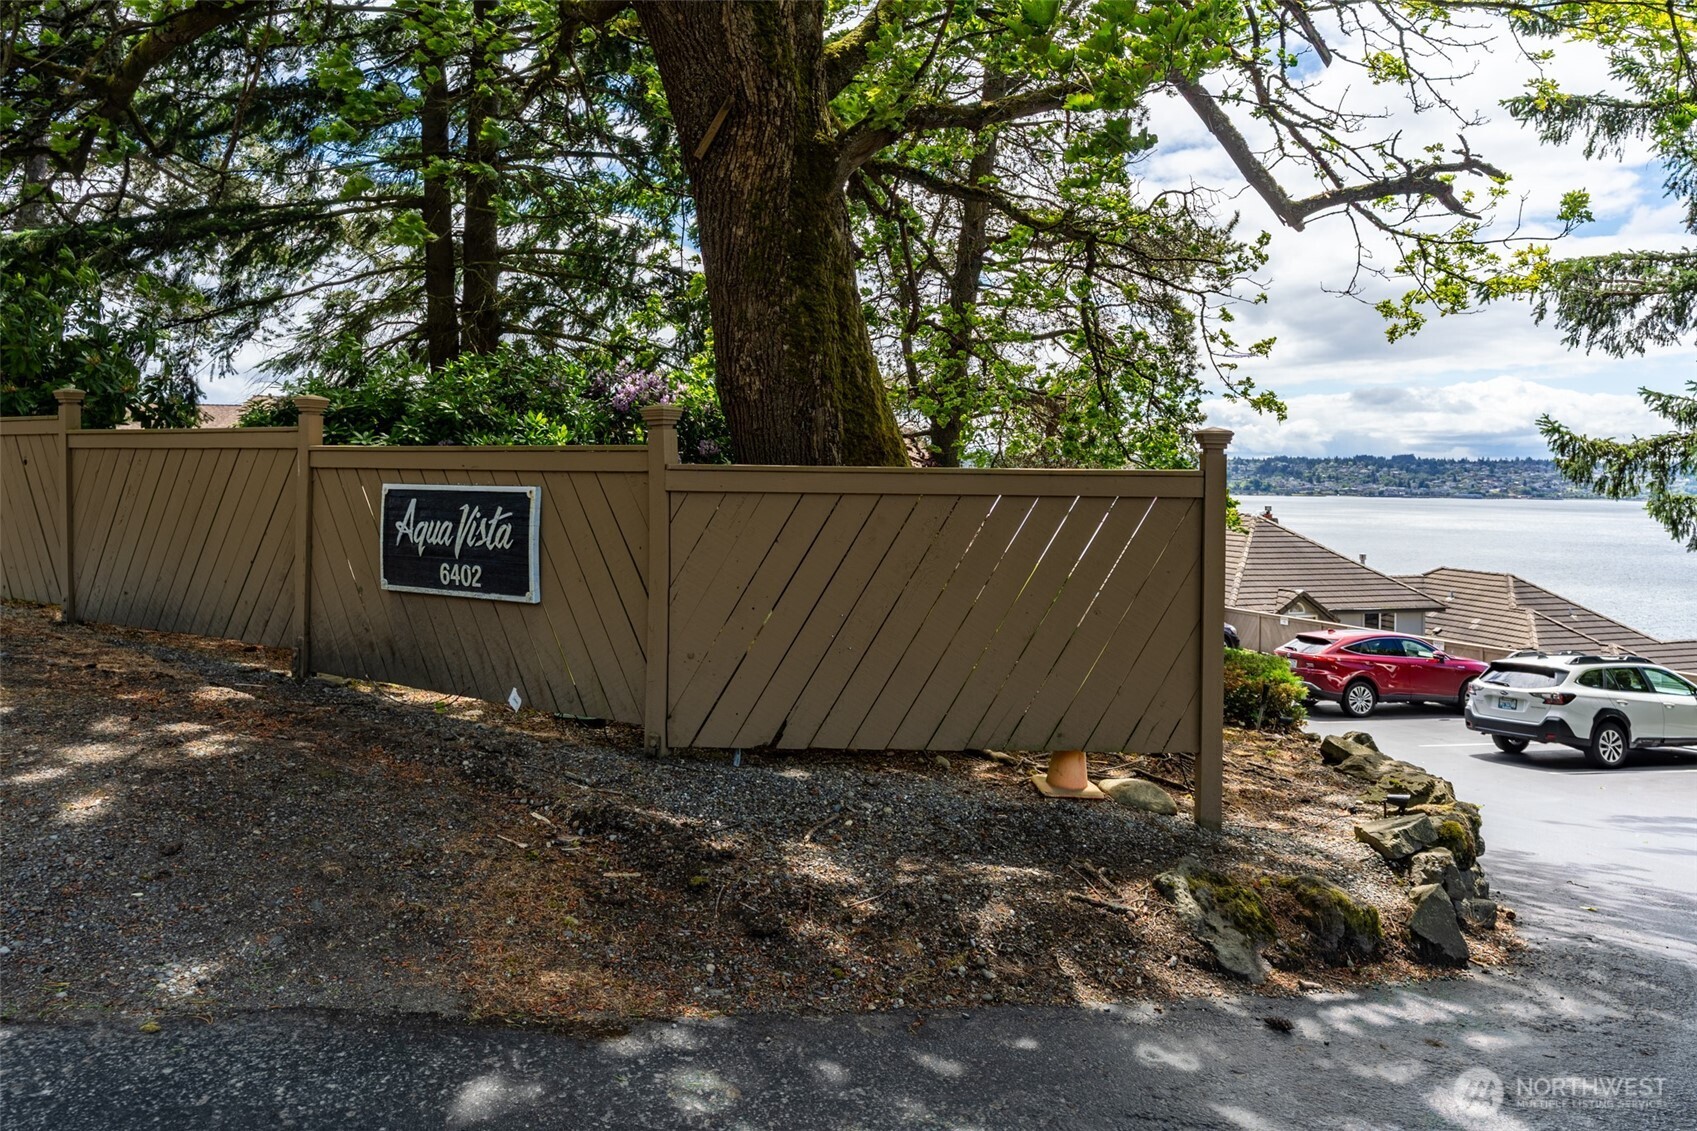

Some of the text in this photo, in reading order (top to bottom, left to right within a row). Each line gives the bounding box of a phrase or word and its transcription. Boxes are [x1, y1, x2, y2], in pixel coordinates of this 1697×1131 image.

[395, 498, 514, 560] Aqua Vista
[440, 563, 482, 588] 6402
